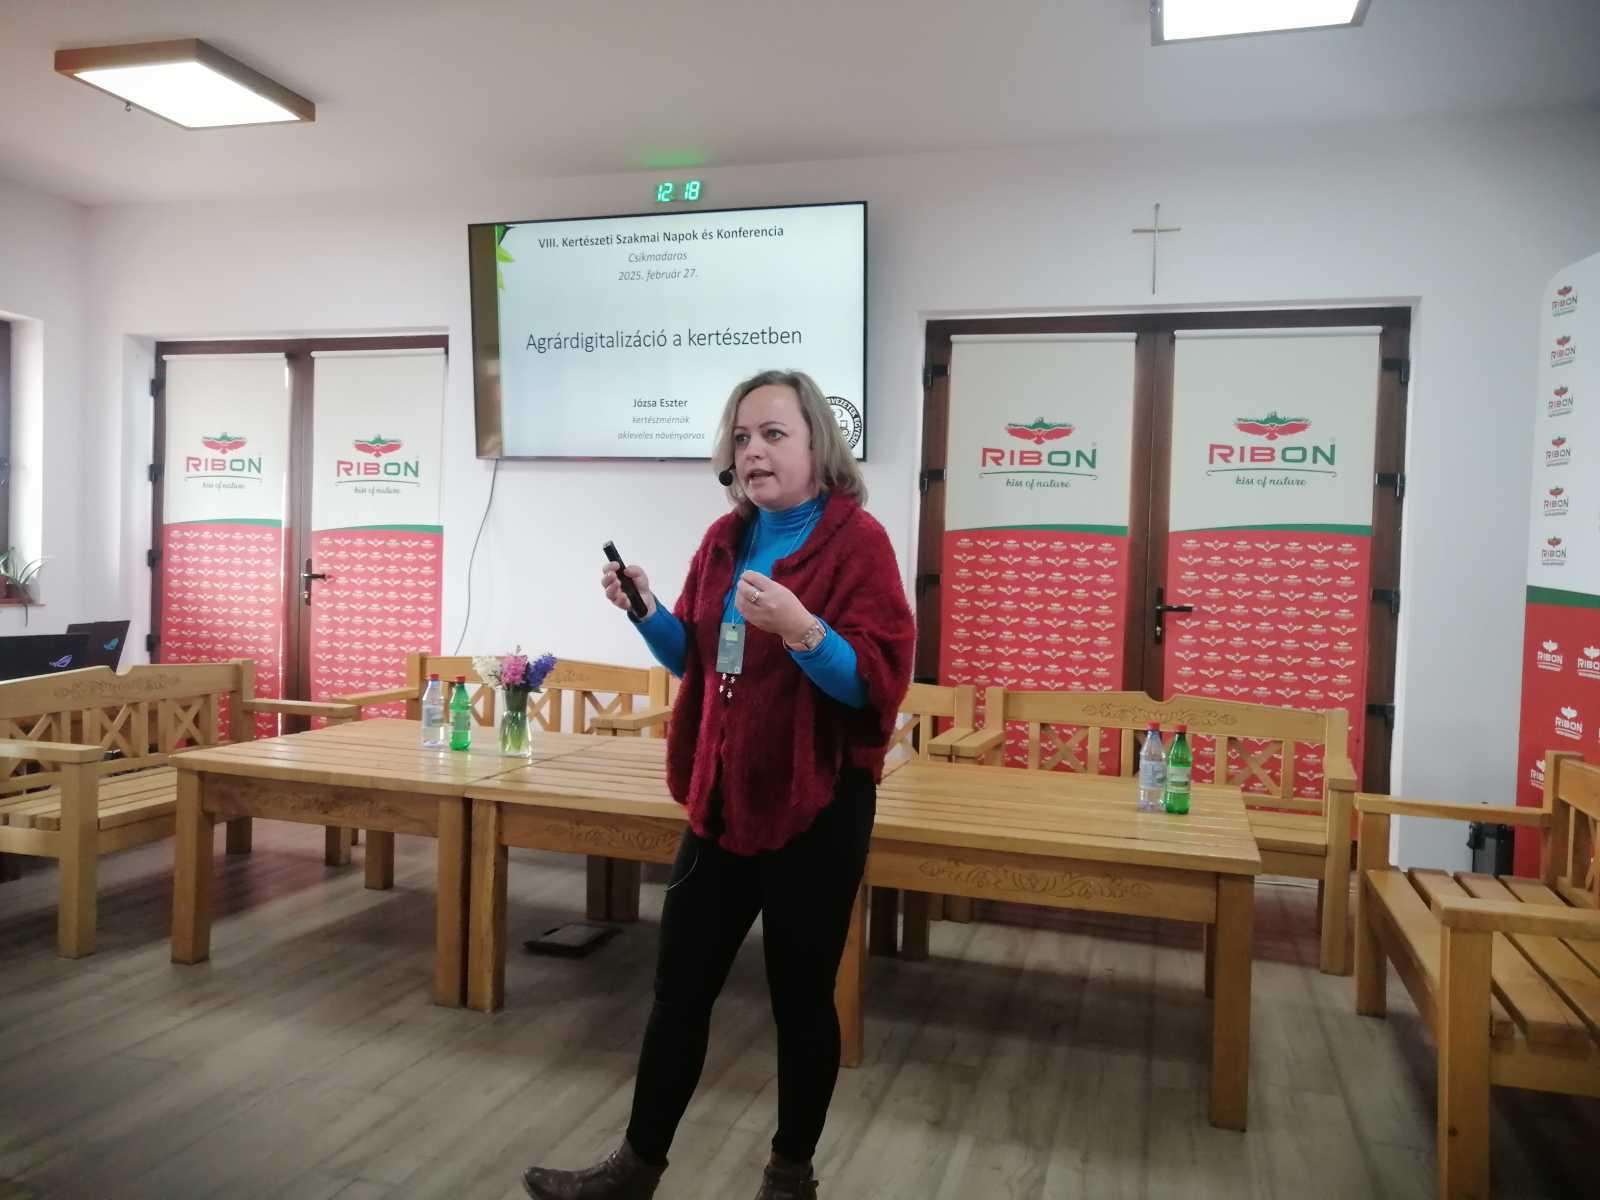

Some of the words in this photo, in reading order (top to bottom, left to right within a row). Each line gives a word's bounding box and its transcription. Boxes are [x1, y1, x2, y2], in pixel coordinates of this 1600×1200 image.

[538, 237, 559, 249] VIII.
[562, 230, 613, 247] Kertészeti
[616, 229, 660, 245] Szakmai
[662, 227, 698, 244] Napok
[701, 230, 714, 240] és
[716, 225, 784, 239] Konferencia
[618, 270, 644, 281] 2025.
[646, 267, 681, 283] február
[683, 268, 699, 280] 27.
[526, 329, 668, 354] Agrárdigitalizáció
[672, 333, 682, 347] a
[688, 326, 802, 346] kertészetben
[633, 398, 657, 408] Józsa
[660, 399, 688, 408] Eszter
[982, 448, 1097, 469] RIBON
[1209, 443, 1336, 466] RIBON
[186, 456, 262, 474] RIBON
[337, 460, 419, 478] RIBON
[1537, 651, 1563, 664] RIBON
[1578, 657, 1600, 670] RIBO
[1555, 717, 1582, 733] RIBON
[1530, 769, 1544, 780] RIB
